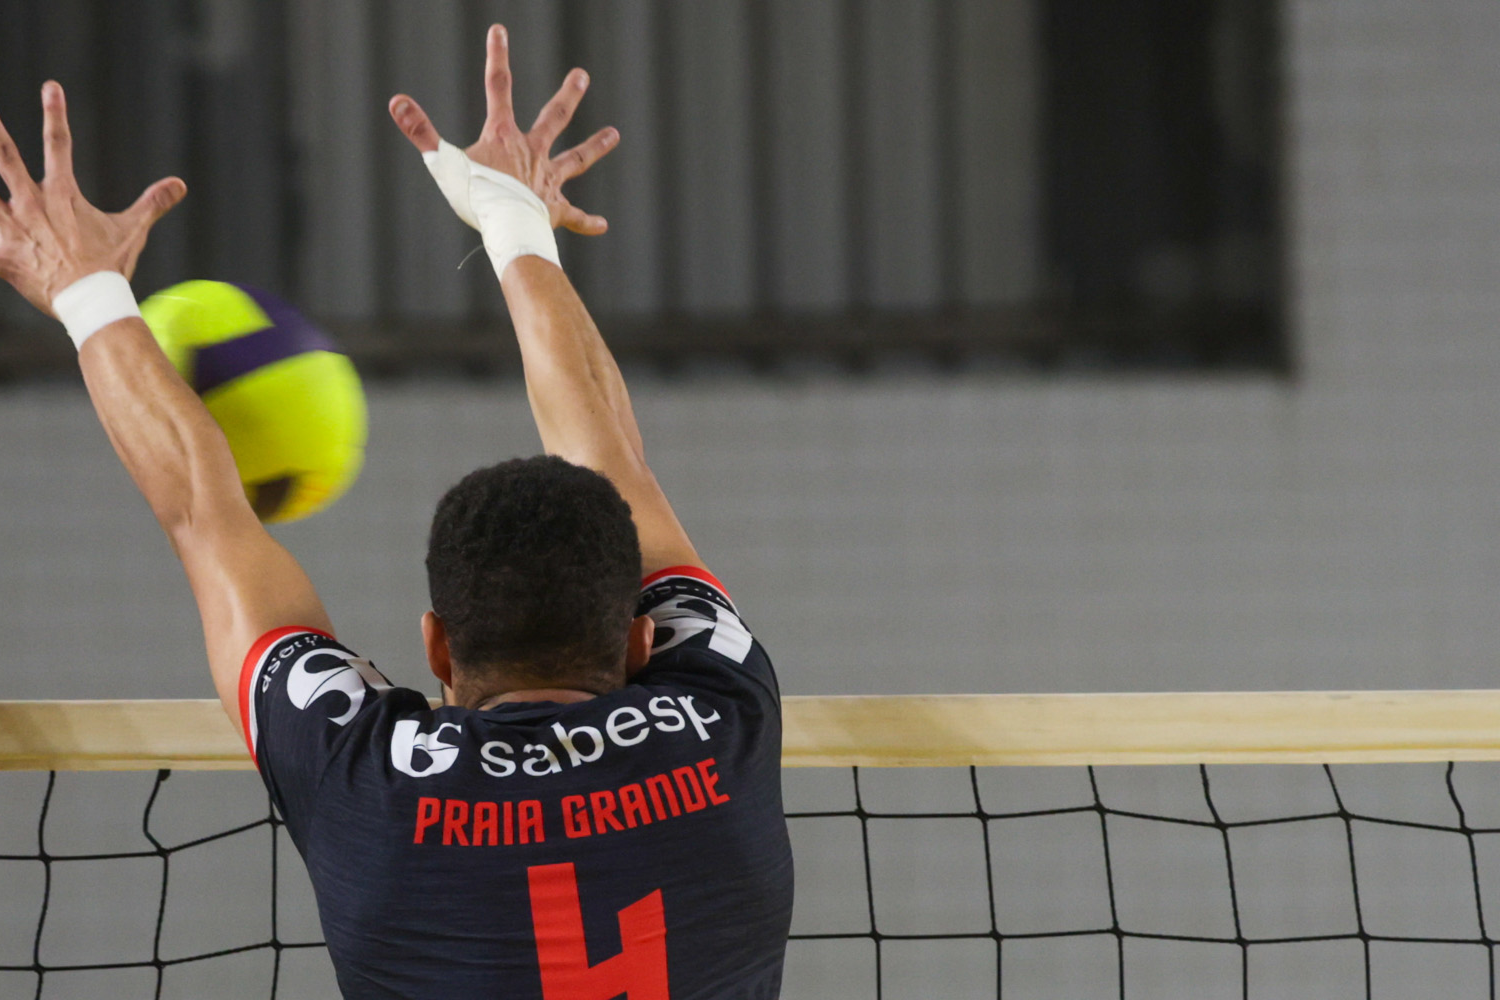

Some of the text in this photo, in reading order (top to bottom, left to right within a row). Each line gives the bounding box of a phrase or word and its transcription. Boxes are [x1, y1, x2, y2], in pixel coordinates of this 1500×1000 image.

[479, 692, 722, 779] sabesp
[412, 756, 732, 848] PRAIA GRANDE
